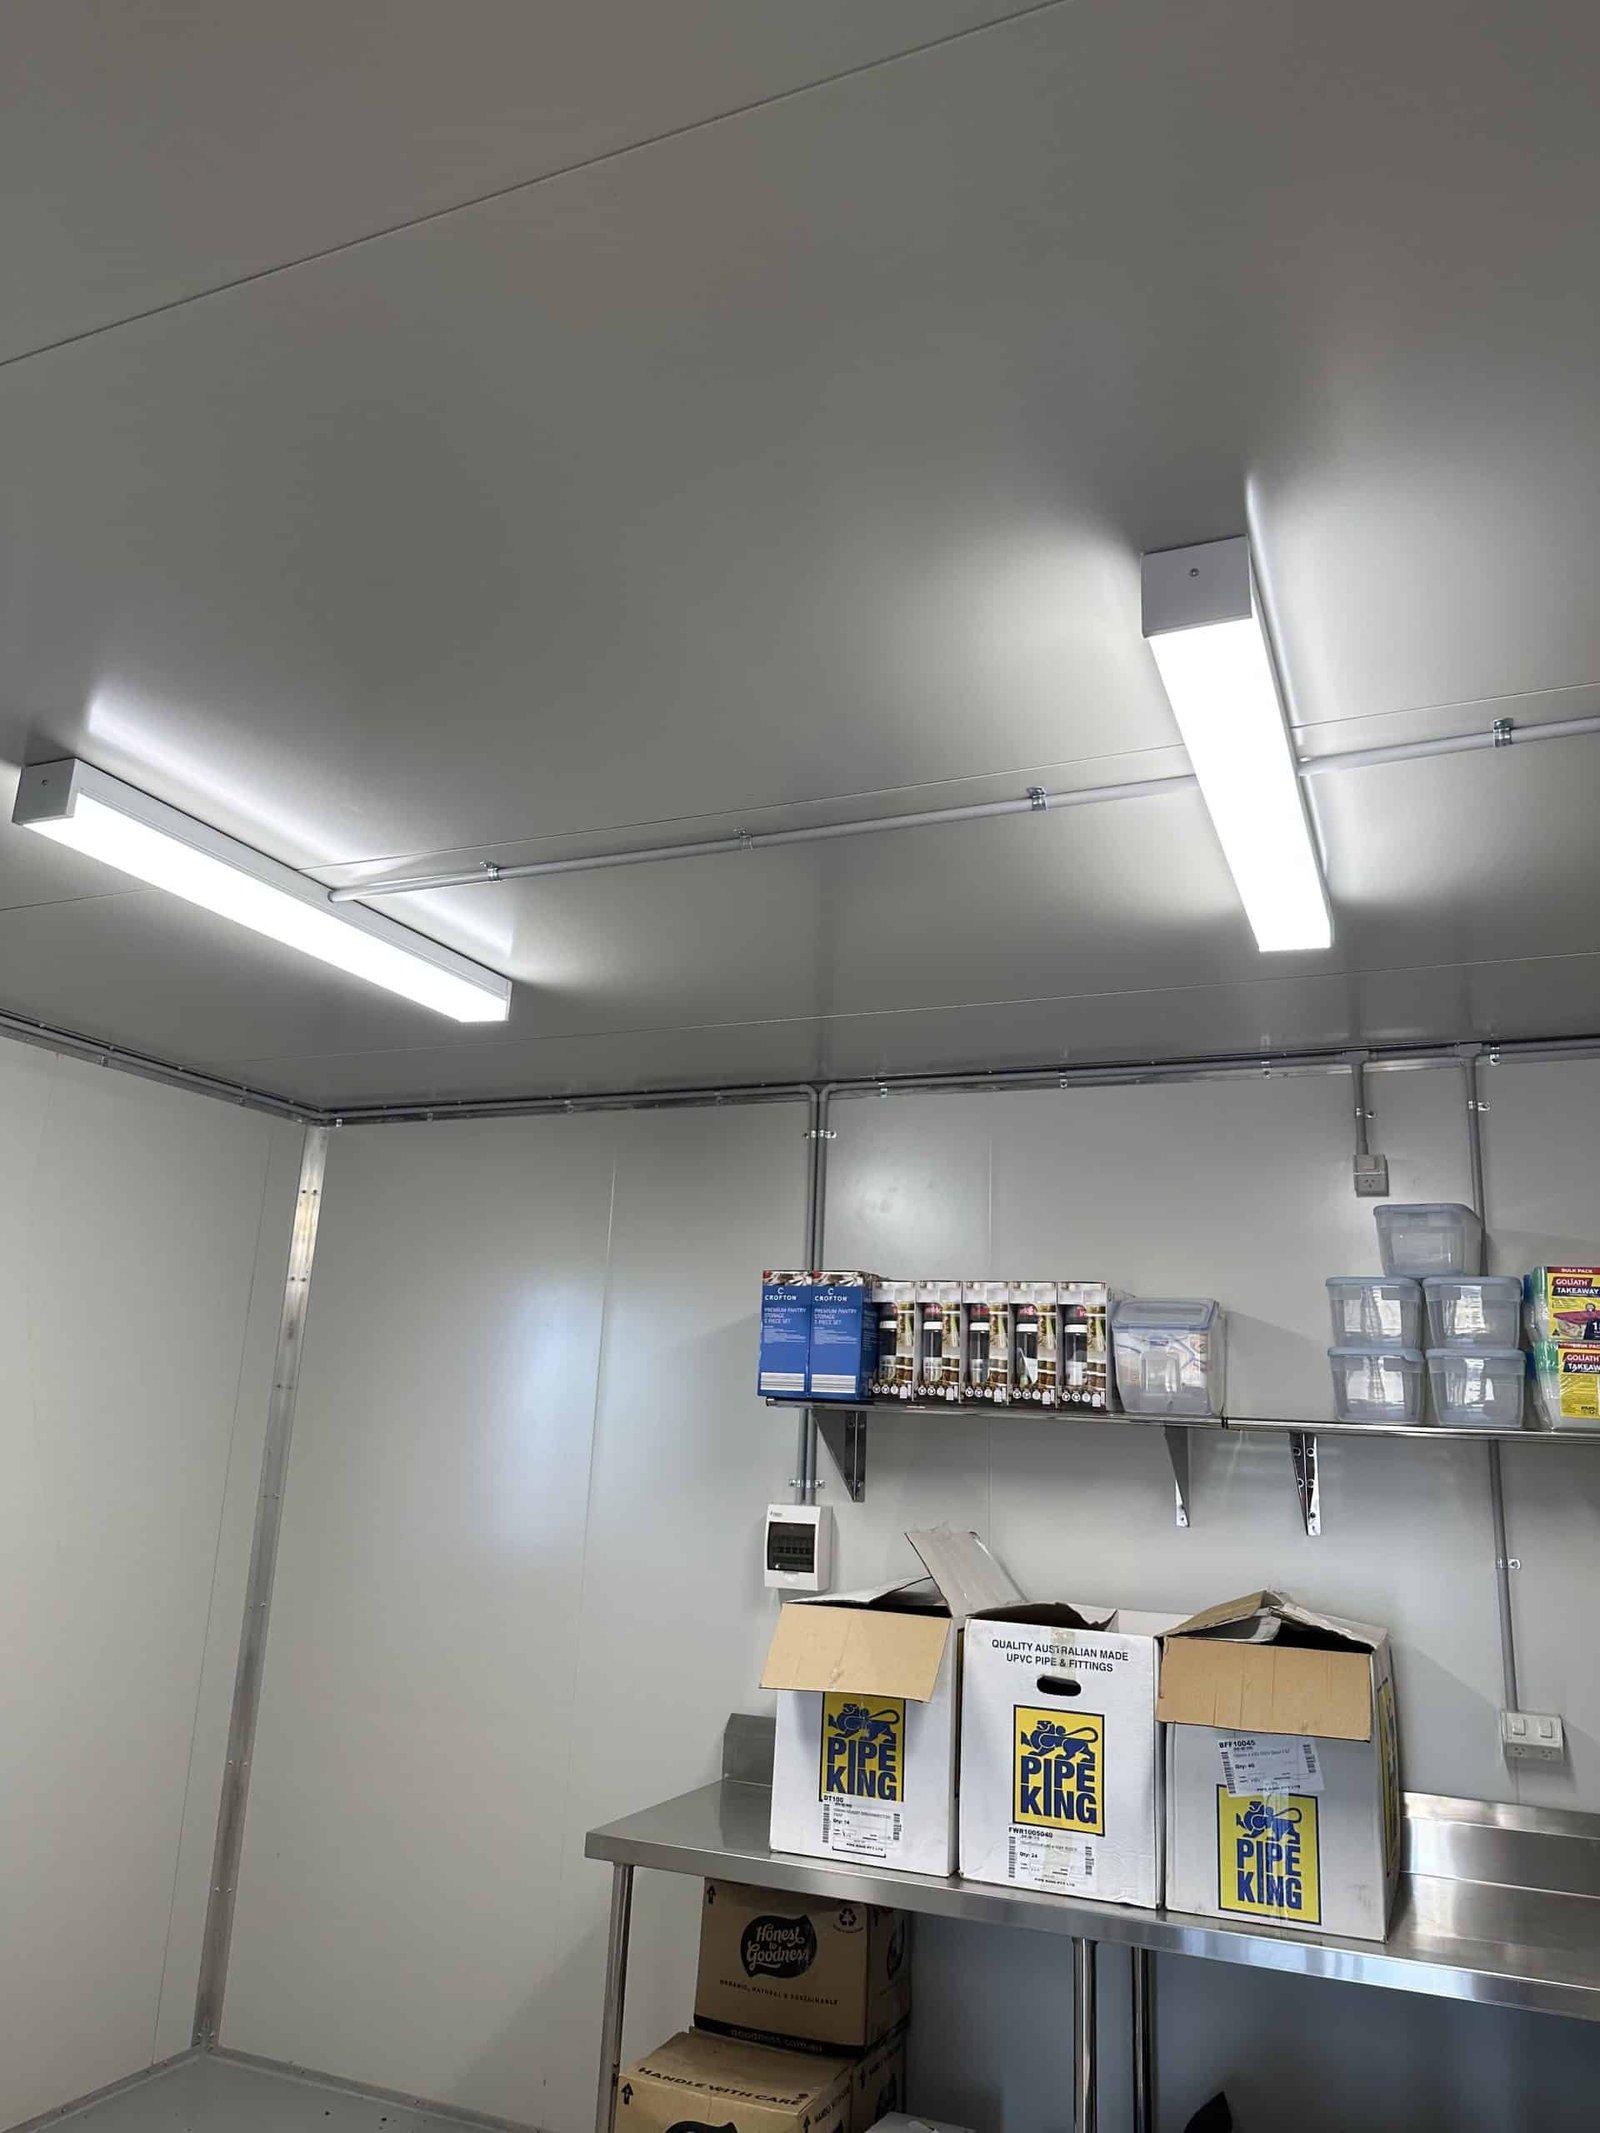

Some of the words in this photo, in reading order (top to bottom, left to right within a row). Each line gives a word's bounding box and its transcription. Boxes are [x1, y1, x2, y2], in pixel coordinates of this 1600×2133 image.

[1555, 1278, 1588, 1286] GOLIATH
[1566, 1354, 1599, 1362] GOLIATH
[991, 1639, 1033, 1652] QUALITY
[1034, 1644, 1098, 1659] AUSTRALIAN
[1099, 1649, 1129, 1662] MADE
[1006, 1652, 1033, 1664] UPVC
[1034, 1656, 1057, 1666] PIPE
[1059, 1658, 1066, 1667] &
[1068, 1659, 1114, 1673] FITTINGS
[827, 1736, 897, 1773] PIPE
[826, 1764, 898, 1801] KING
[1020, 1754, 1096, 1794] PIPE
[1019, 1784, 1098, 1825] KING
[1236, 1838, 1302, 1878] PIPE
[1236, 1869, 1303, 1911] KING
[755, 1923, 806, 1945] Honest
[768, 1942, 778, 1950] to
[746, 1941, 810, 1971] Goodness
[638, 2066, 706, 2089] HANDLE
[708, 2084, 752, 2098] WITH
[753, 2092, 802, 2106] CARE
